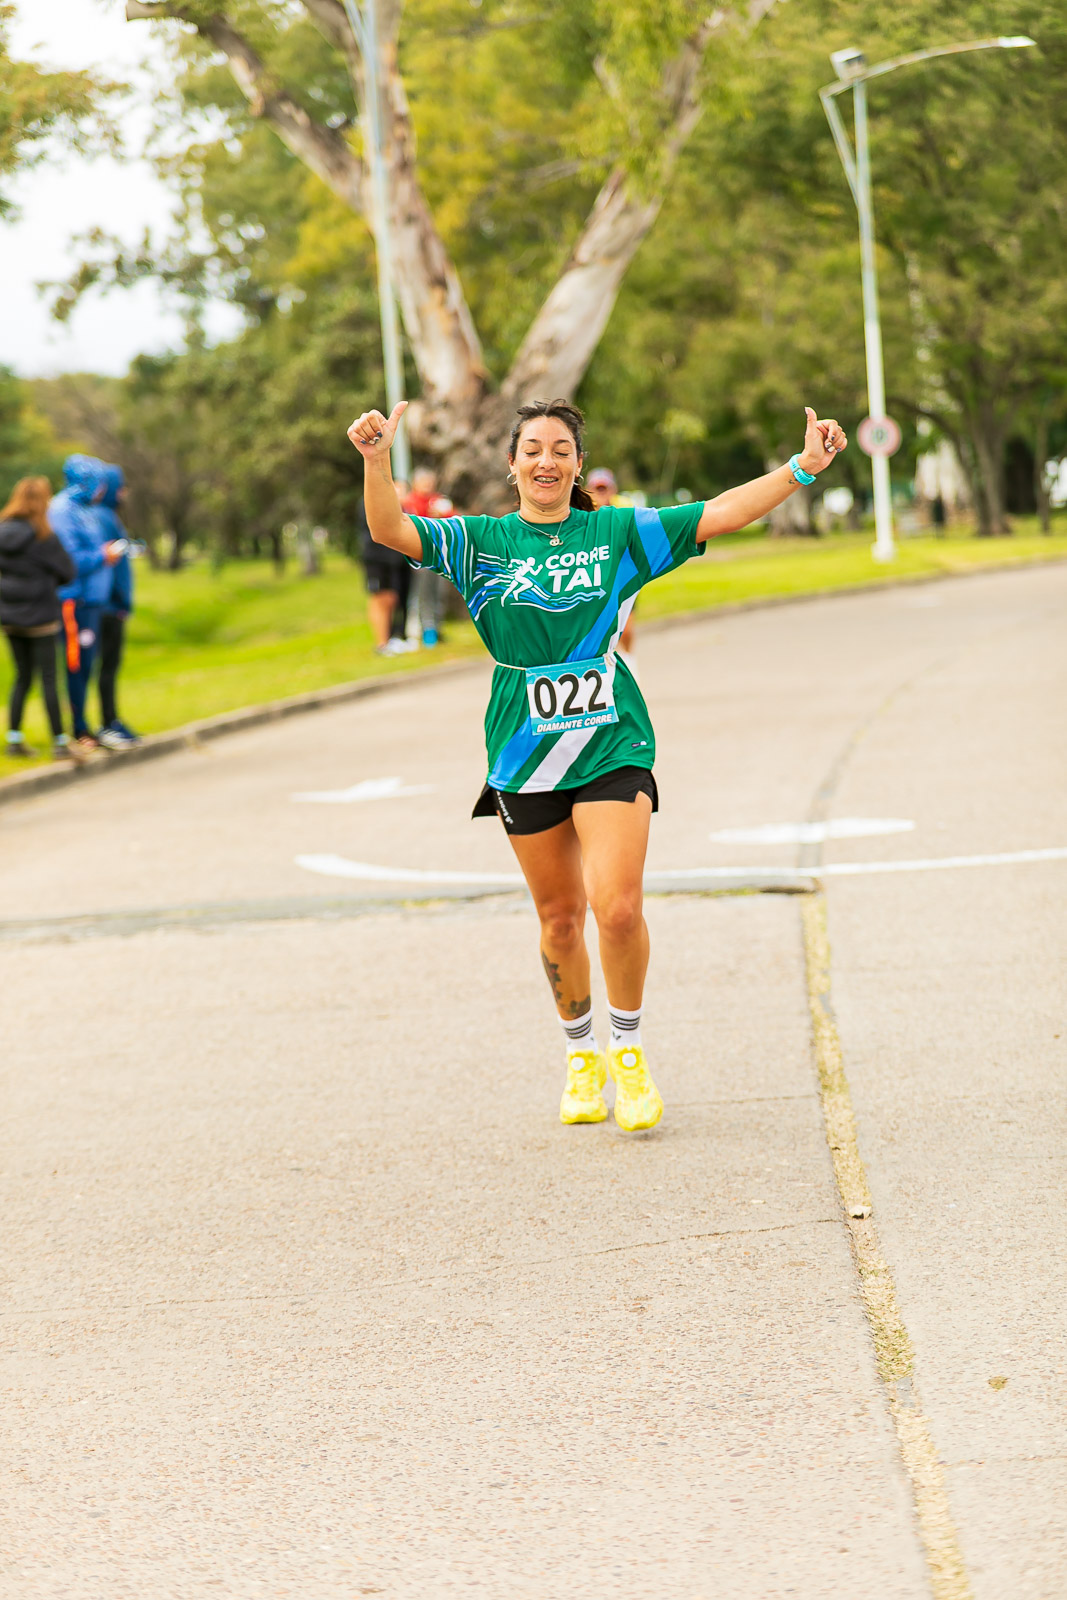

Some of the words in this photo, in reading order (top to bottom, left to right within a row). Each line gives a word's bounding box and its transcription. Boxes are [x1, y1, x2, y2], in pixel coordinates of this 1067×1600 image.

[545, 545, 610, 570] CORRE
[548, 563, 602, 594] TAI
[533, 669, 607, 719] 022
[536, 719, 583, 733] DIAMANTE
[584, 713, 612, 727] CORRE
